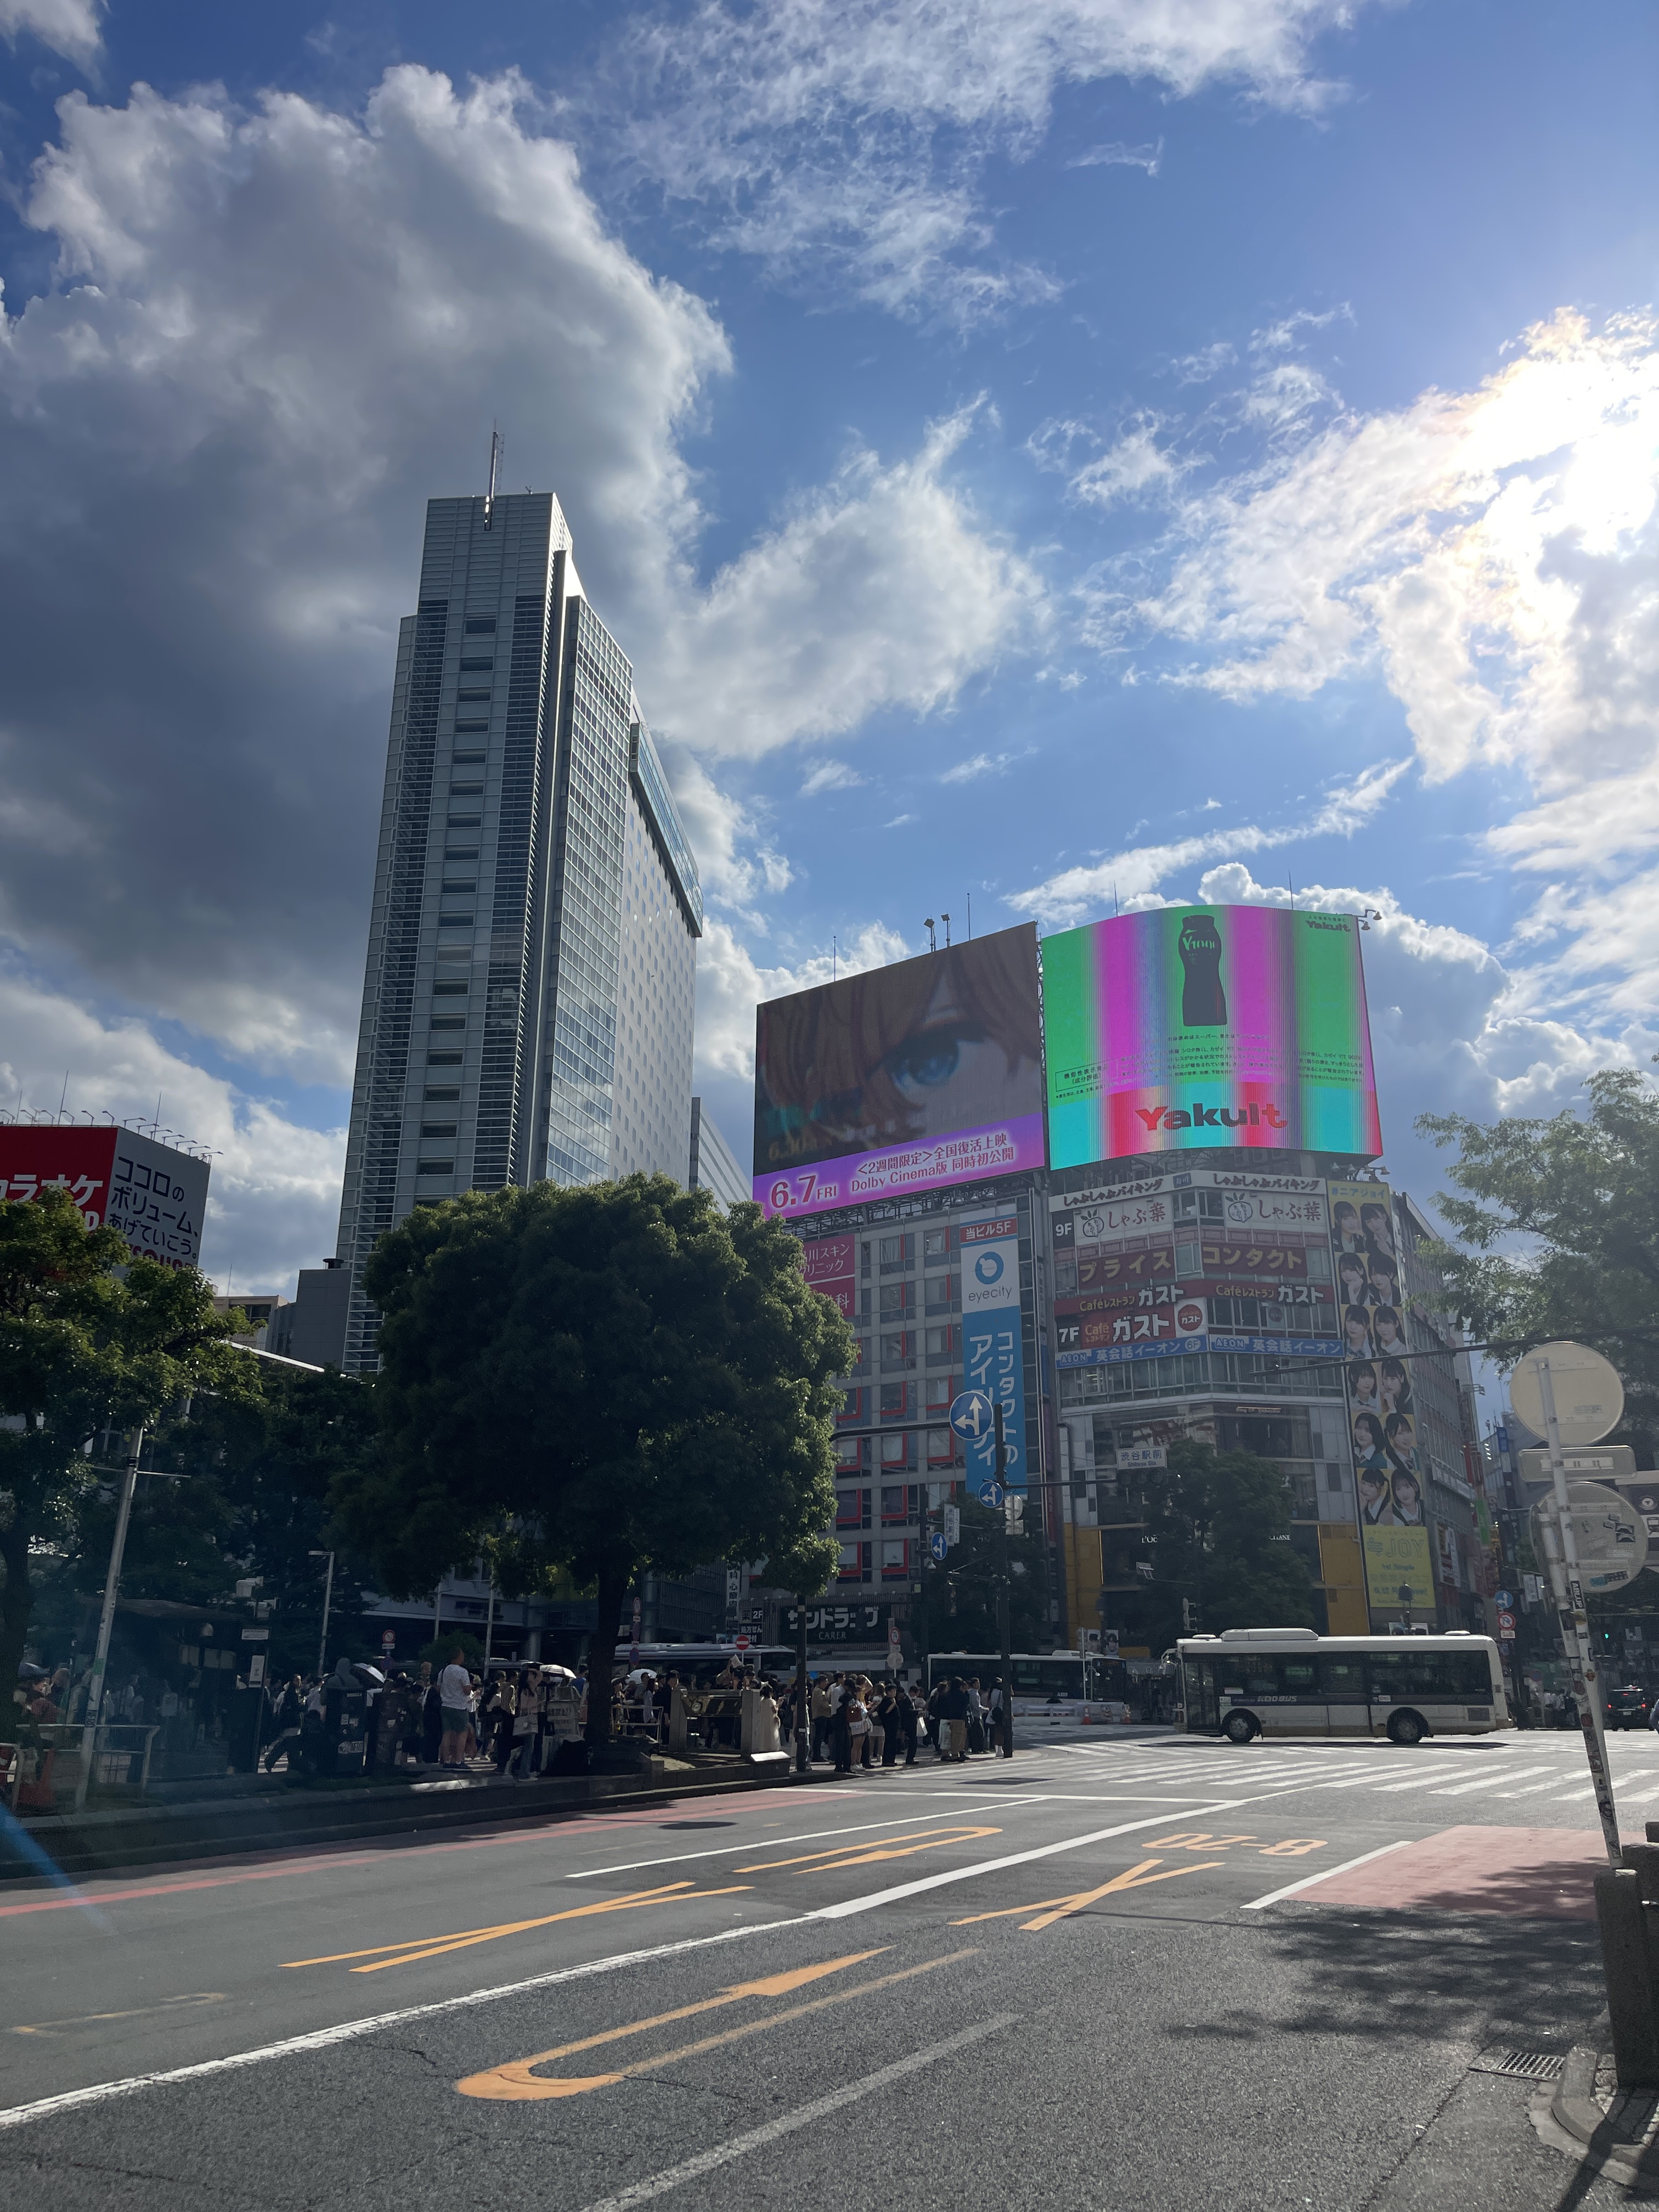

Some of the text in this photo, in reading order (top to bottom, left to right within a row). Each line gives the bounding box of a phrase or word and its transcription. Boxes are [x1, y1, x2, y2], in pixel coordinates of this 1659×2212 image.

[1305, 920, 1351, 932] Yakult
[1135, 1102, 1288, 1131] Yakult
[115, 1156, 185, 1202] ココロの
[851, 1147, 1014, 1193] Dolby Cinema版 同時初公開
[770, 1175, 837, 1209] 6.7 FRI
[1063, 1178, 1164, 1207] しゃぶしゃぶバイキング
[1213, 1173, 1321, 1191] しゃぶしゃぶバイキング
[1108, 1201, 1166, 1229] しゃぶ葉
[1259, 1200, 1322, 1222] しゃぶ葉
[966, 1220, 1012, 1240] 当ビル5F
[1055, 1222, 1073, 1237] 9F
[799, 1259, 844, 1277] クリニック
[1079, 1250, 1172, 1283] プライス
[1202, 1246, 1302, 1269] コンタクト
[968, 1285, 1013, 1304] eyecity
[1138, 1284, 1184, 1307] ガスト
[1278, 1284, 1324, 1305] ガスト
[1112, 1313, 1170, 1342] ガスト
[1181, 1315, 1200, 1324] ガスト
[1059, 1327, 1080, 1343] 7F
[1060, 1340, 1200, 1365] AEON 英会話イーオン 6F
[1216, 1338, 1341, 1354] AEON 英会話イーオン
[1120, 1449, 1162, 1462] 渋谷駅前
[753, 1610, 763, 1620] 2F
